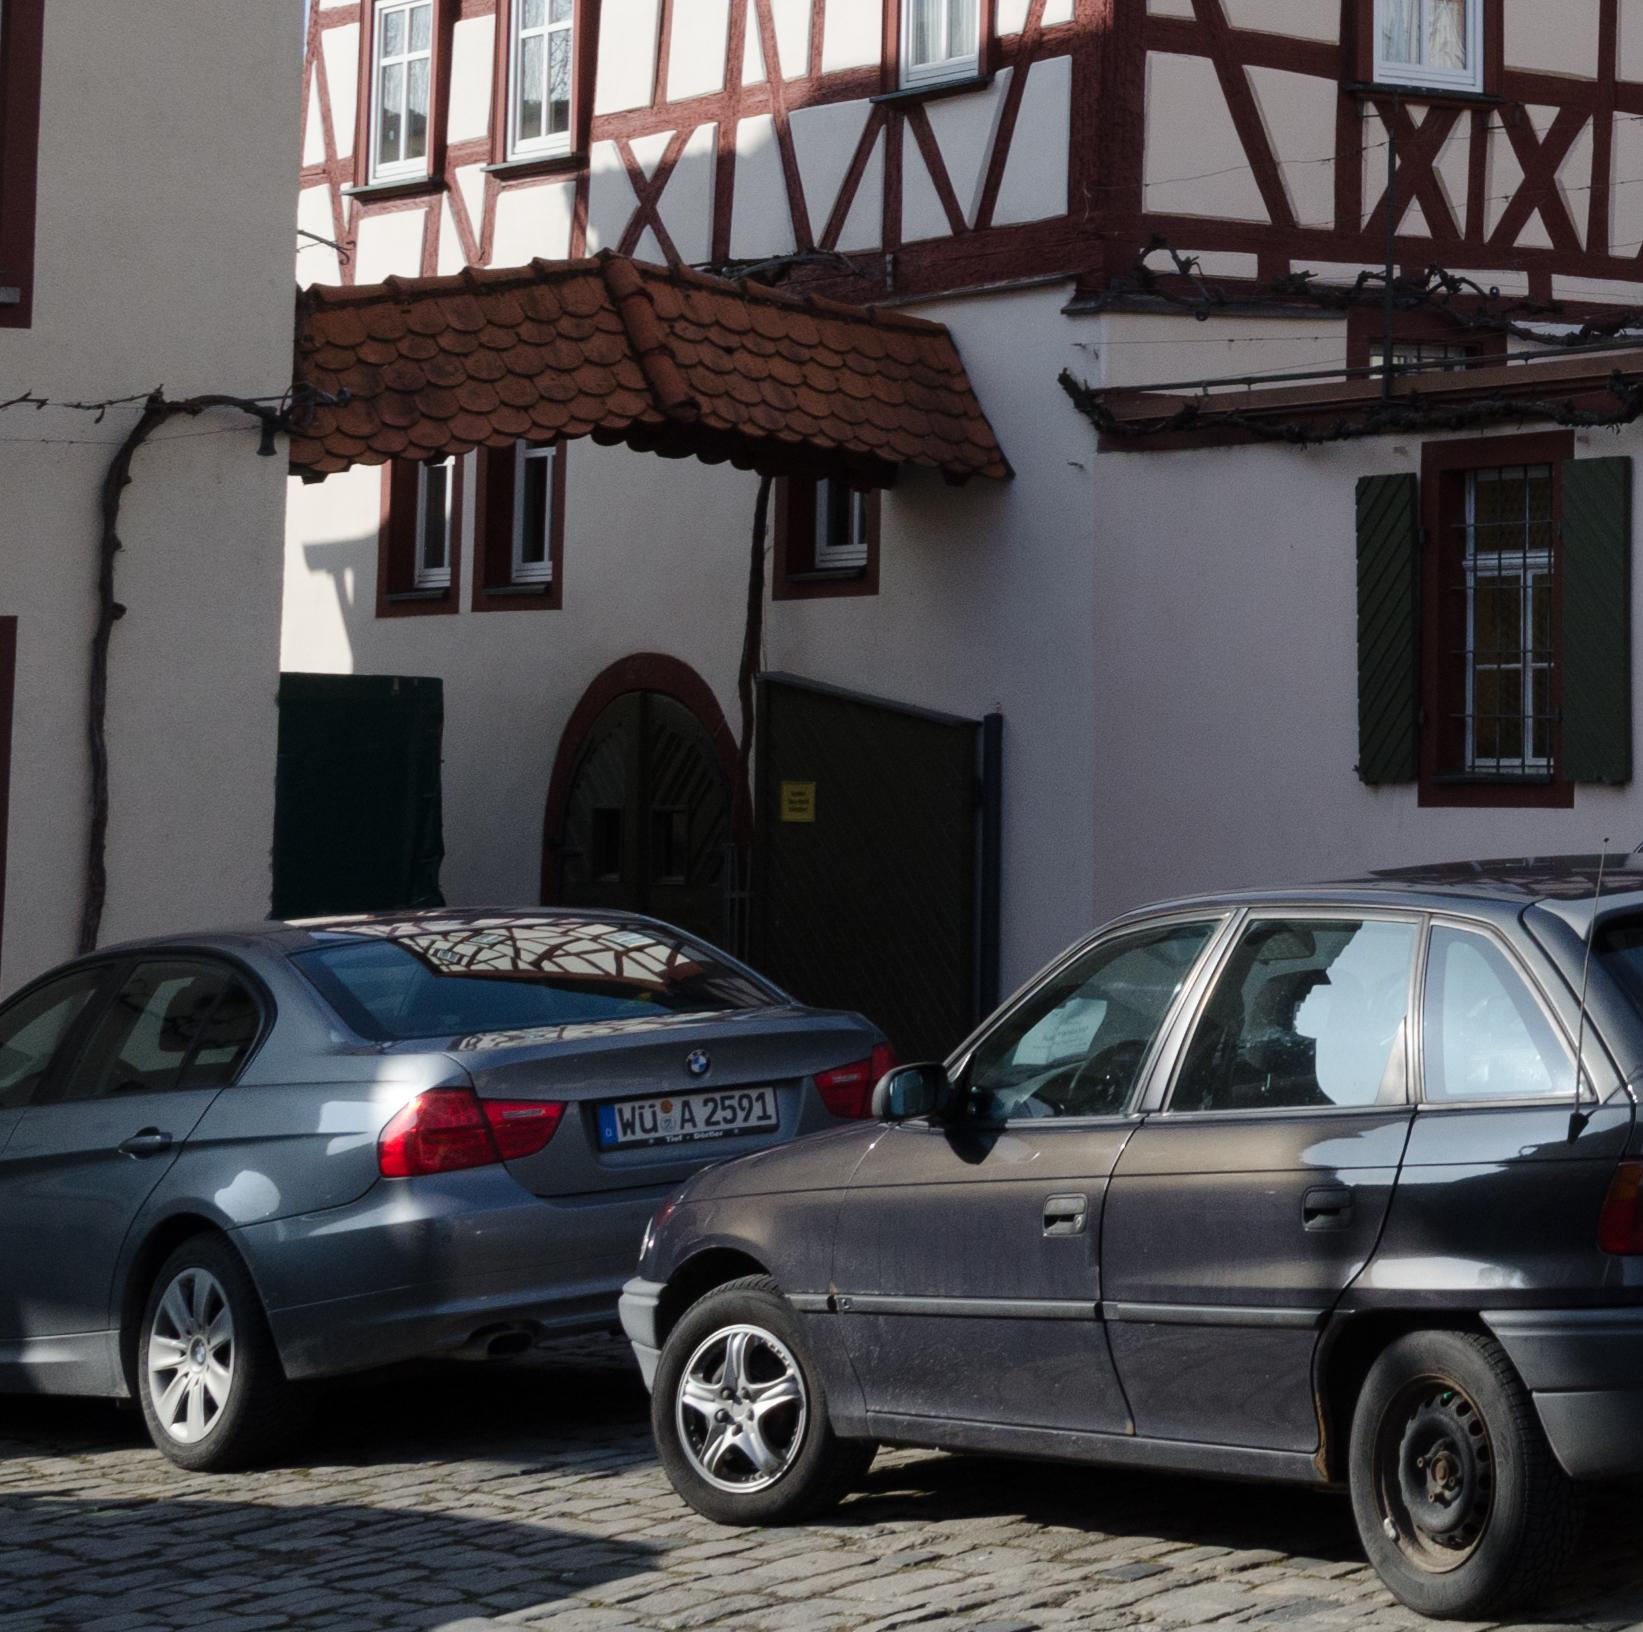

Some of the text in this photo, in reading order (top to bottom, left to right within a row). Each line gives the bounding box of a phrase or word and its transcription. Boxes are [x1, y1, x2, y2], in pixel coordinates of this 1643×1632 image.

[617, 1104, 658, 1138] WÜ
[680, 1100, 697, 1130] A
[703, 1092, 772, 1127] 2591
